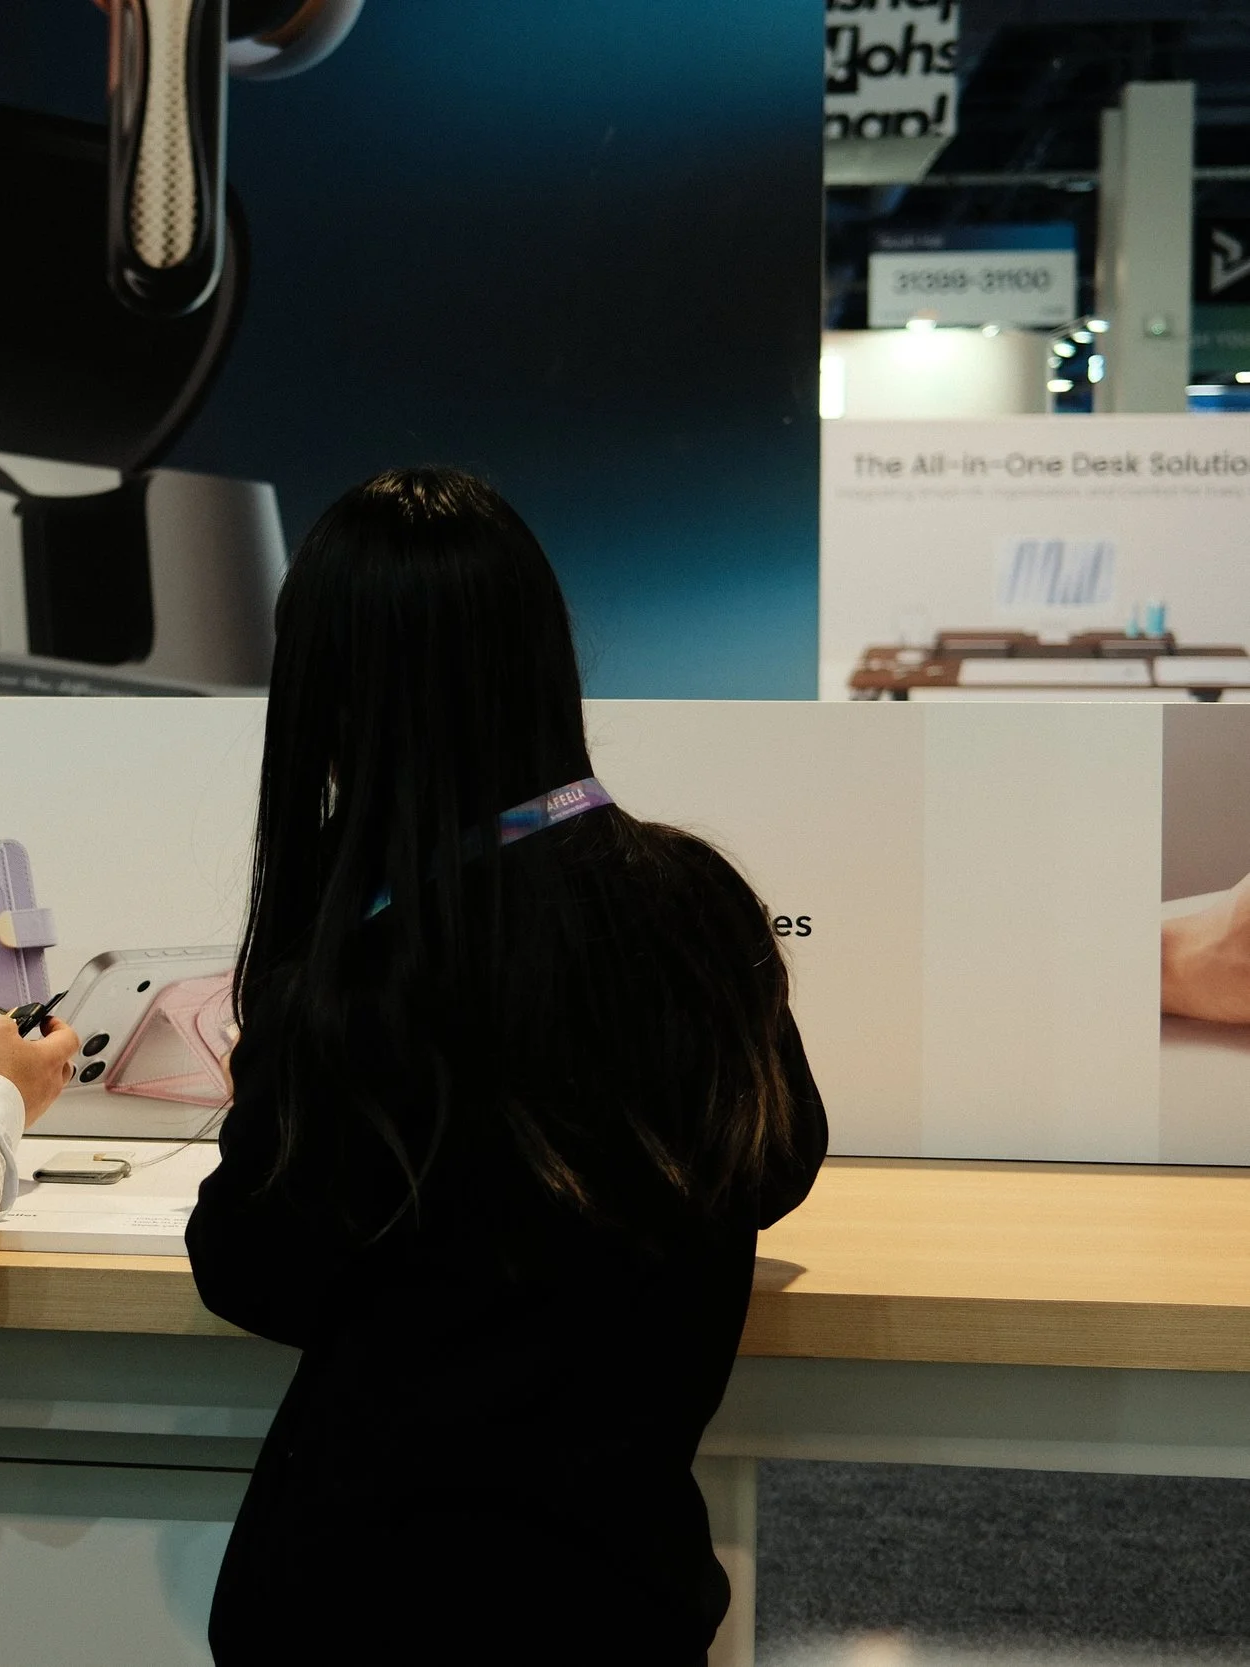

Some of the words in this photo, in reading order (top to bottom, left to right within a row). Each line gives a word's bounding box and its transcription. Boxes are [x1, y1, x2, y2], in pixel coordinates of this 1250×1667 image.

[853, 452, 903, 478] The
[909, 450, 1064, 479] All-in-One
[1072, 450, 1140, 478] Desk
[547, 788, 587, 812] AFEELA
